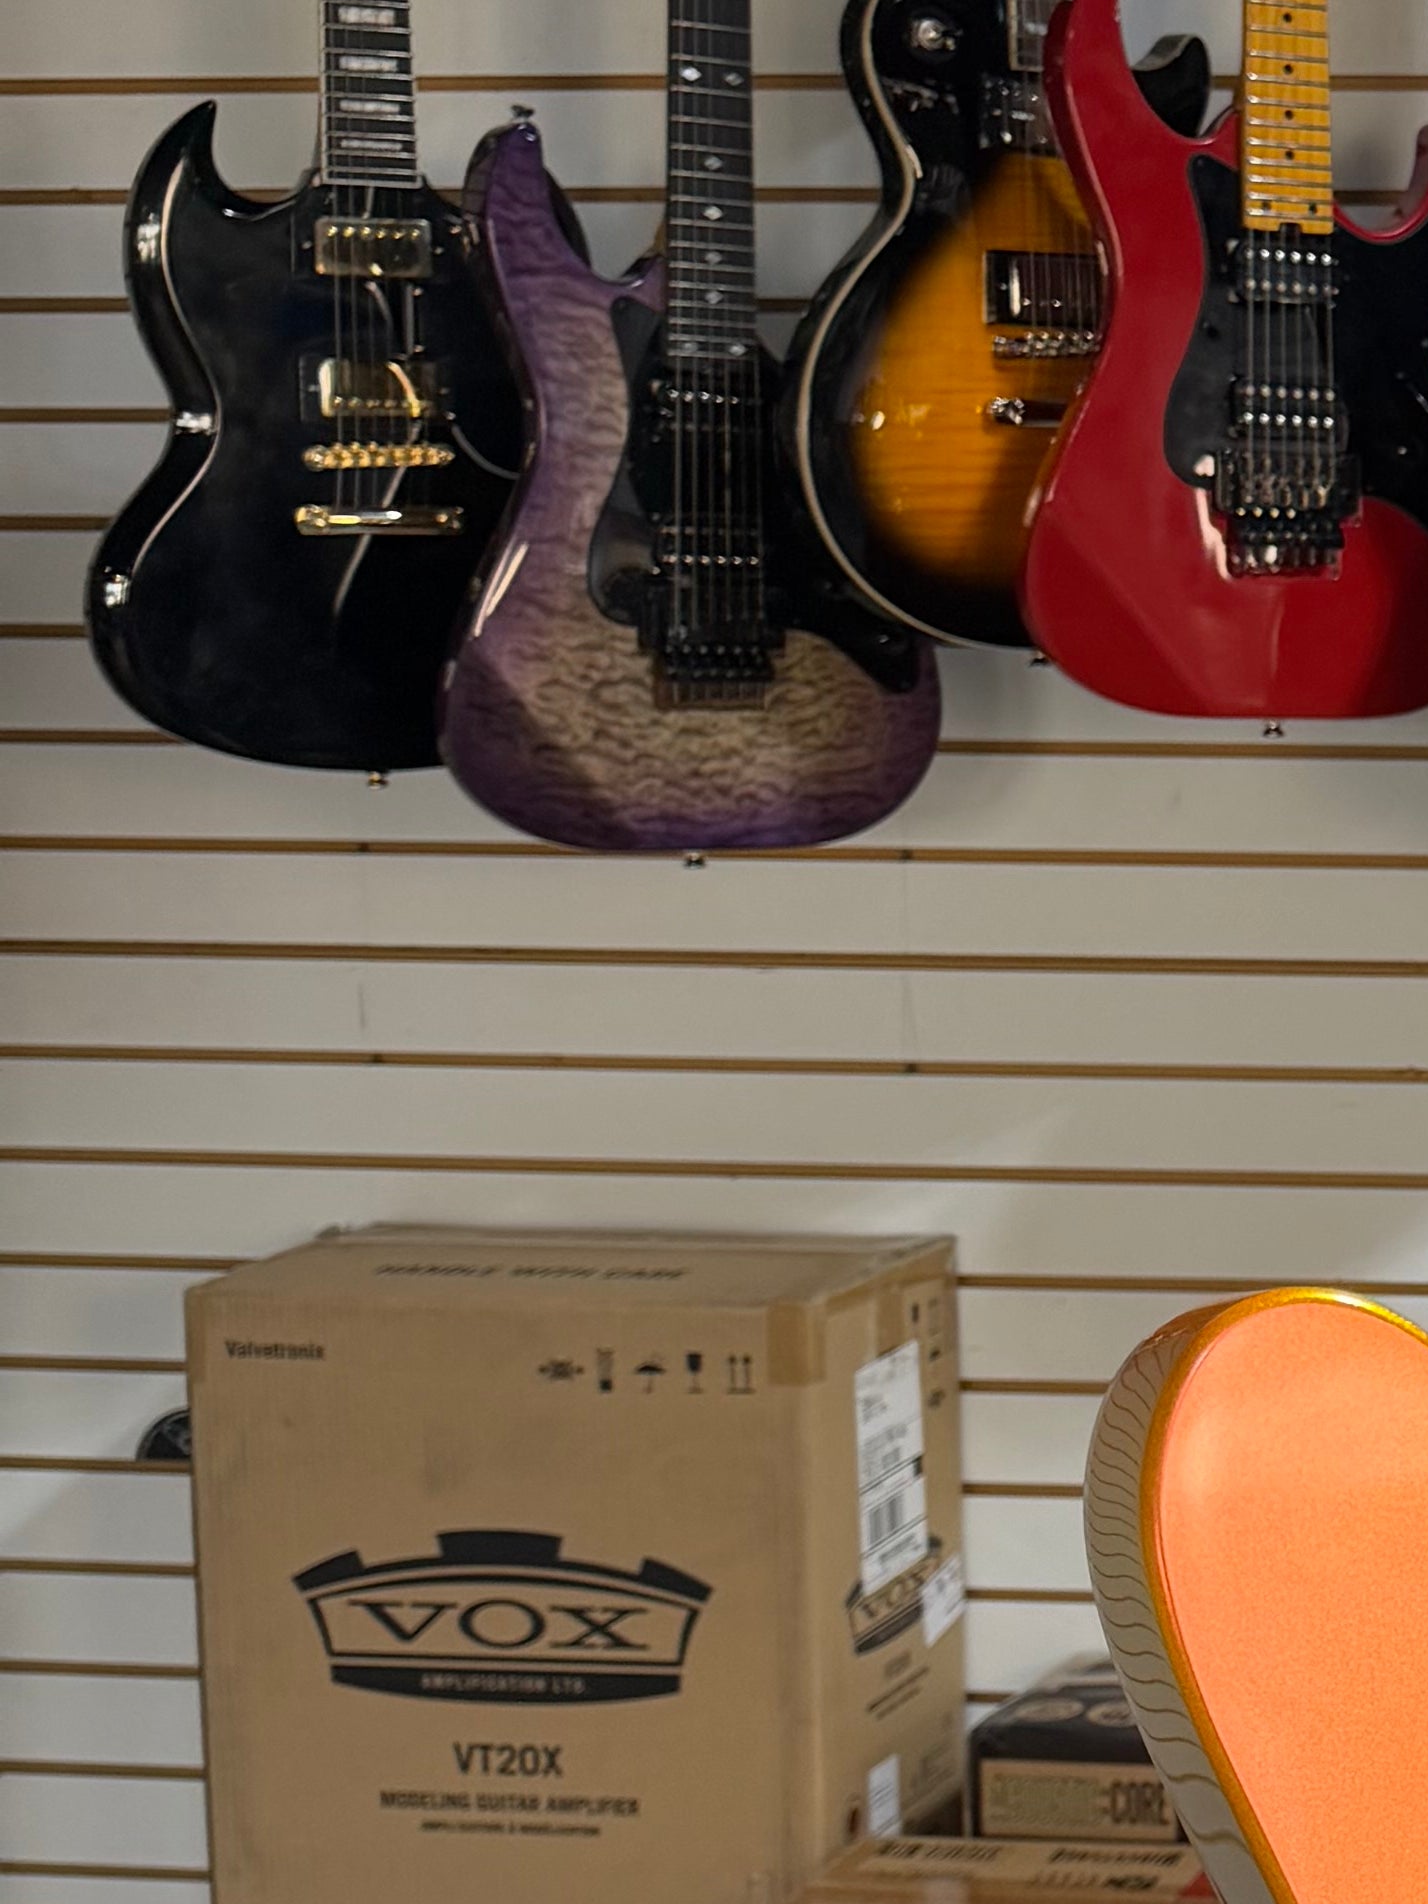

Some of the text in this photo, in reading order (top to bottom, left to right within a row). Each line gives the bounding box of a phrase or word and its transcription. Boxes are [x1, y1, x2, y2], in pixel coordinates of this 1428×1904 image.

[348, 1598, 650, 1651] VOX
[451, 1741, 564, 1778] VT20X
[379, 1790, 641, 1817] MODELING GUITAR AMPLIFIER
